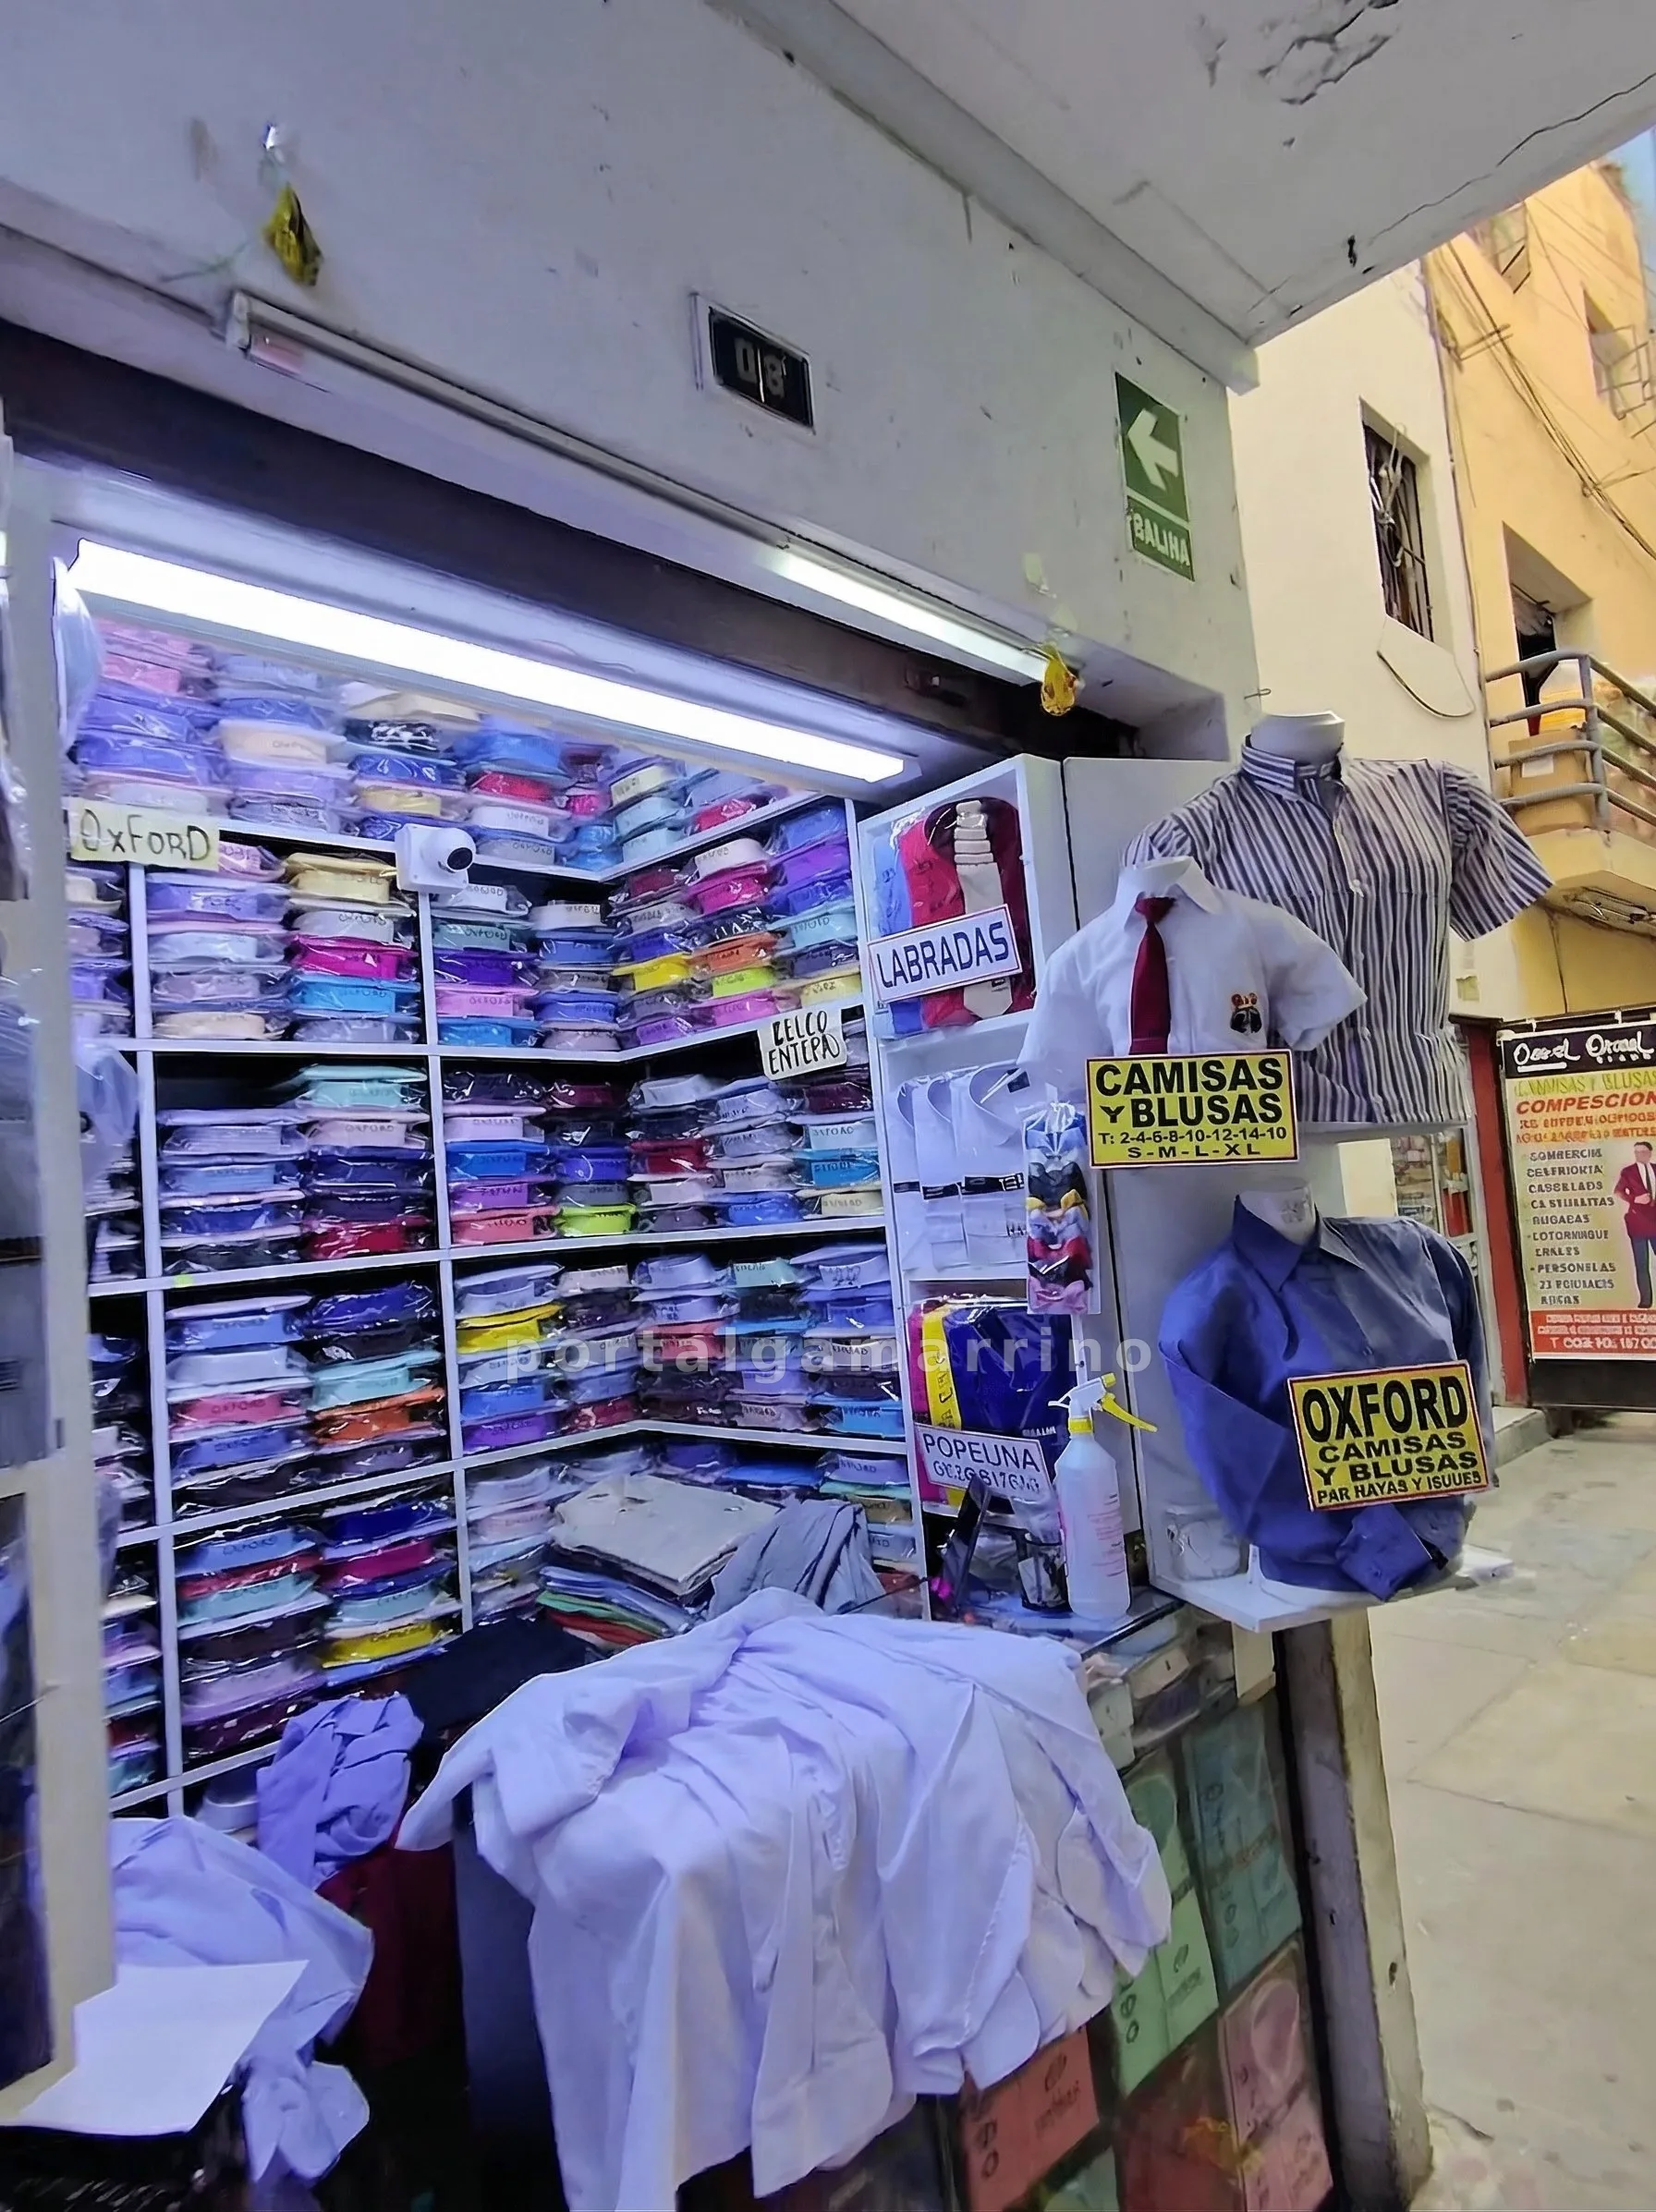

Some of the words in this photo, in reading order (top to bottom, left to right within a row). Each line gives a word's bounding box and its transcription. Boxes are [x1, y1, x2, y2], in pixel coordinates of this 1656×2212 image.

[877, 921, 1009, 989] LABRADAS
[1095, 1057, 1284, 1097] CAMISAS
[1100, 1105, 1126, 1124] Y
[1130, 1093, 1283, 1128] BLUSAS
[1098, 1133, 1114, 1145] T:
[1302, 1375, 1468, 1444] OXFORD
[1318, 1431, 1467, 1464] CAMISAS
[1314, 1466, 1336, 1487] Y
[1348, 1452, 1479, 1482] BLUSAS
[1317, 1487, 1351, 1504] PAR
[1411, 1477, 1423, 1491] Y
